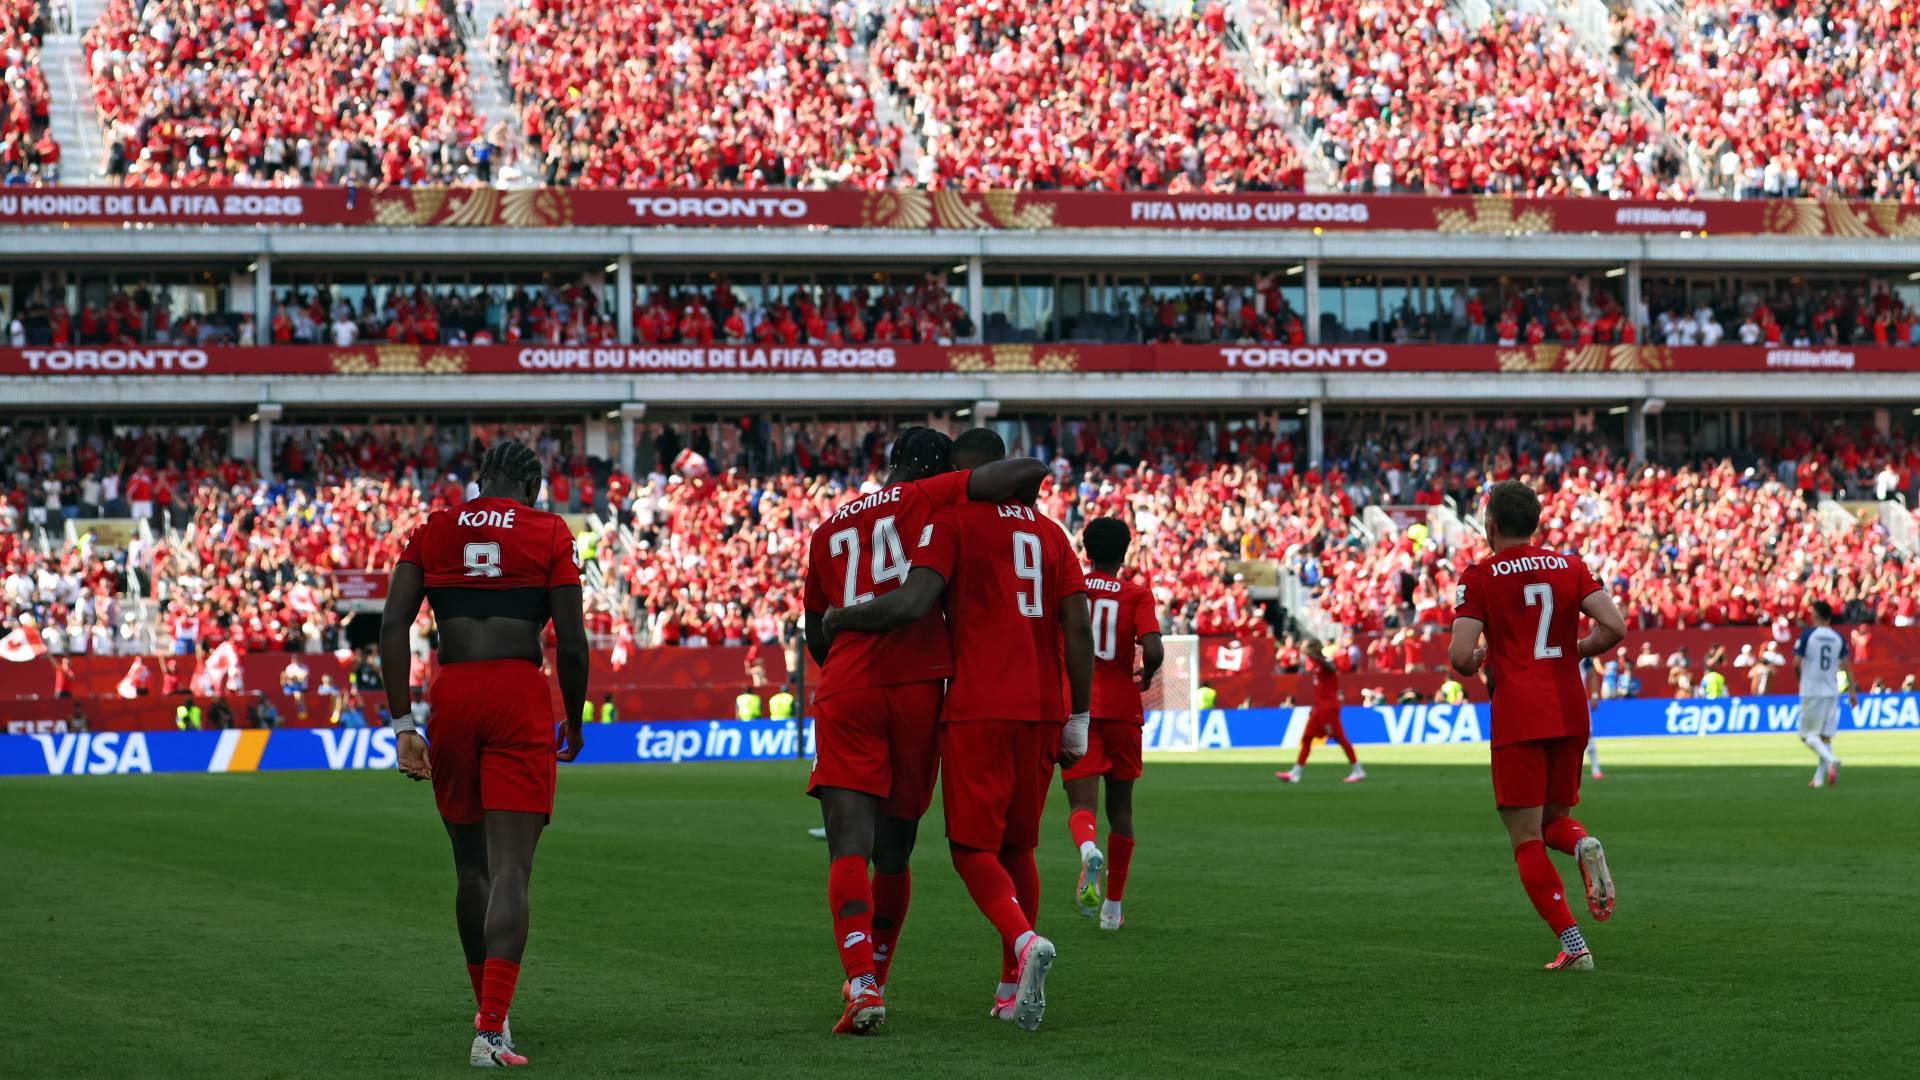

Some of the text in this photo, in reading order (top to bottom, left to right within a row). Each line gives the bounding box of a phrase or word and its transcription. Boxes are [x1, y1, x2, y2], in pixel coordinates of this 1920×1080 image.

[22, 196, 101, 215] MONDE
[105, 196, 134, 215] DE
[138, 196, 166, 214] LA
[171, 196, 219, 214] FIFA
[224, 196, 303, 215] 2026
[629, 198, 807, 218] TORONTO
[1132, 202, 1369, 222] FIFA WORLD CUP 2026
[23, 350, 208, 369] TORONTO
[518, 349, 896, 368] COUPE DU MONDE DE LA FIFA 2026
[1221, 348, 1388, 367] TORONTO
[832, 486, 902, 523] PROMISE
[463, 541, 503, 578] 8
[829, 515, 912, 607] 24
[1013, 531, 1043, 617] 9
[1491, 555, 1569, 577] JOHNSTON
[1523, 582, 1563, 660] 2
[1819, 644, 1832, 672] 6
[1372, 703, 1482, 744] VISA
[1665, 701, 1725, 737] tap
[1727, 697, 1760, 731] in
[1843, 696, 1920, 728] VISA
[30, 732, 153, 775] VISA
[310, 727, 400, 770] VIS
[636, 725, 702, 763] tap
[705, 721, 741, 757] in
